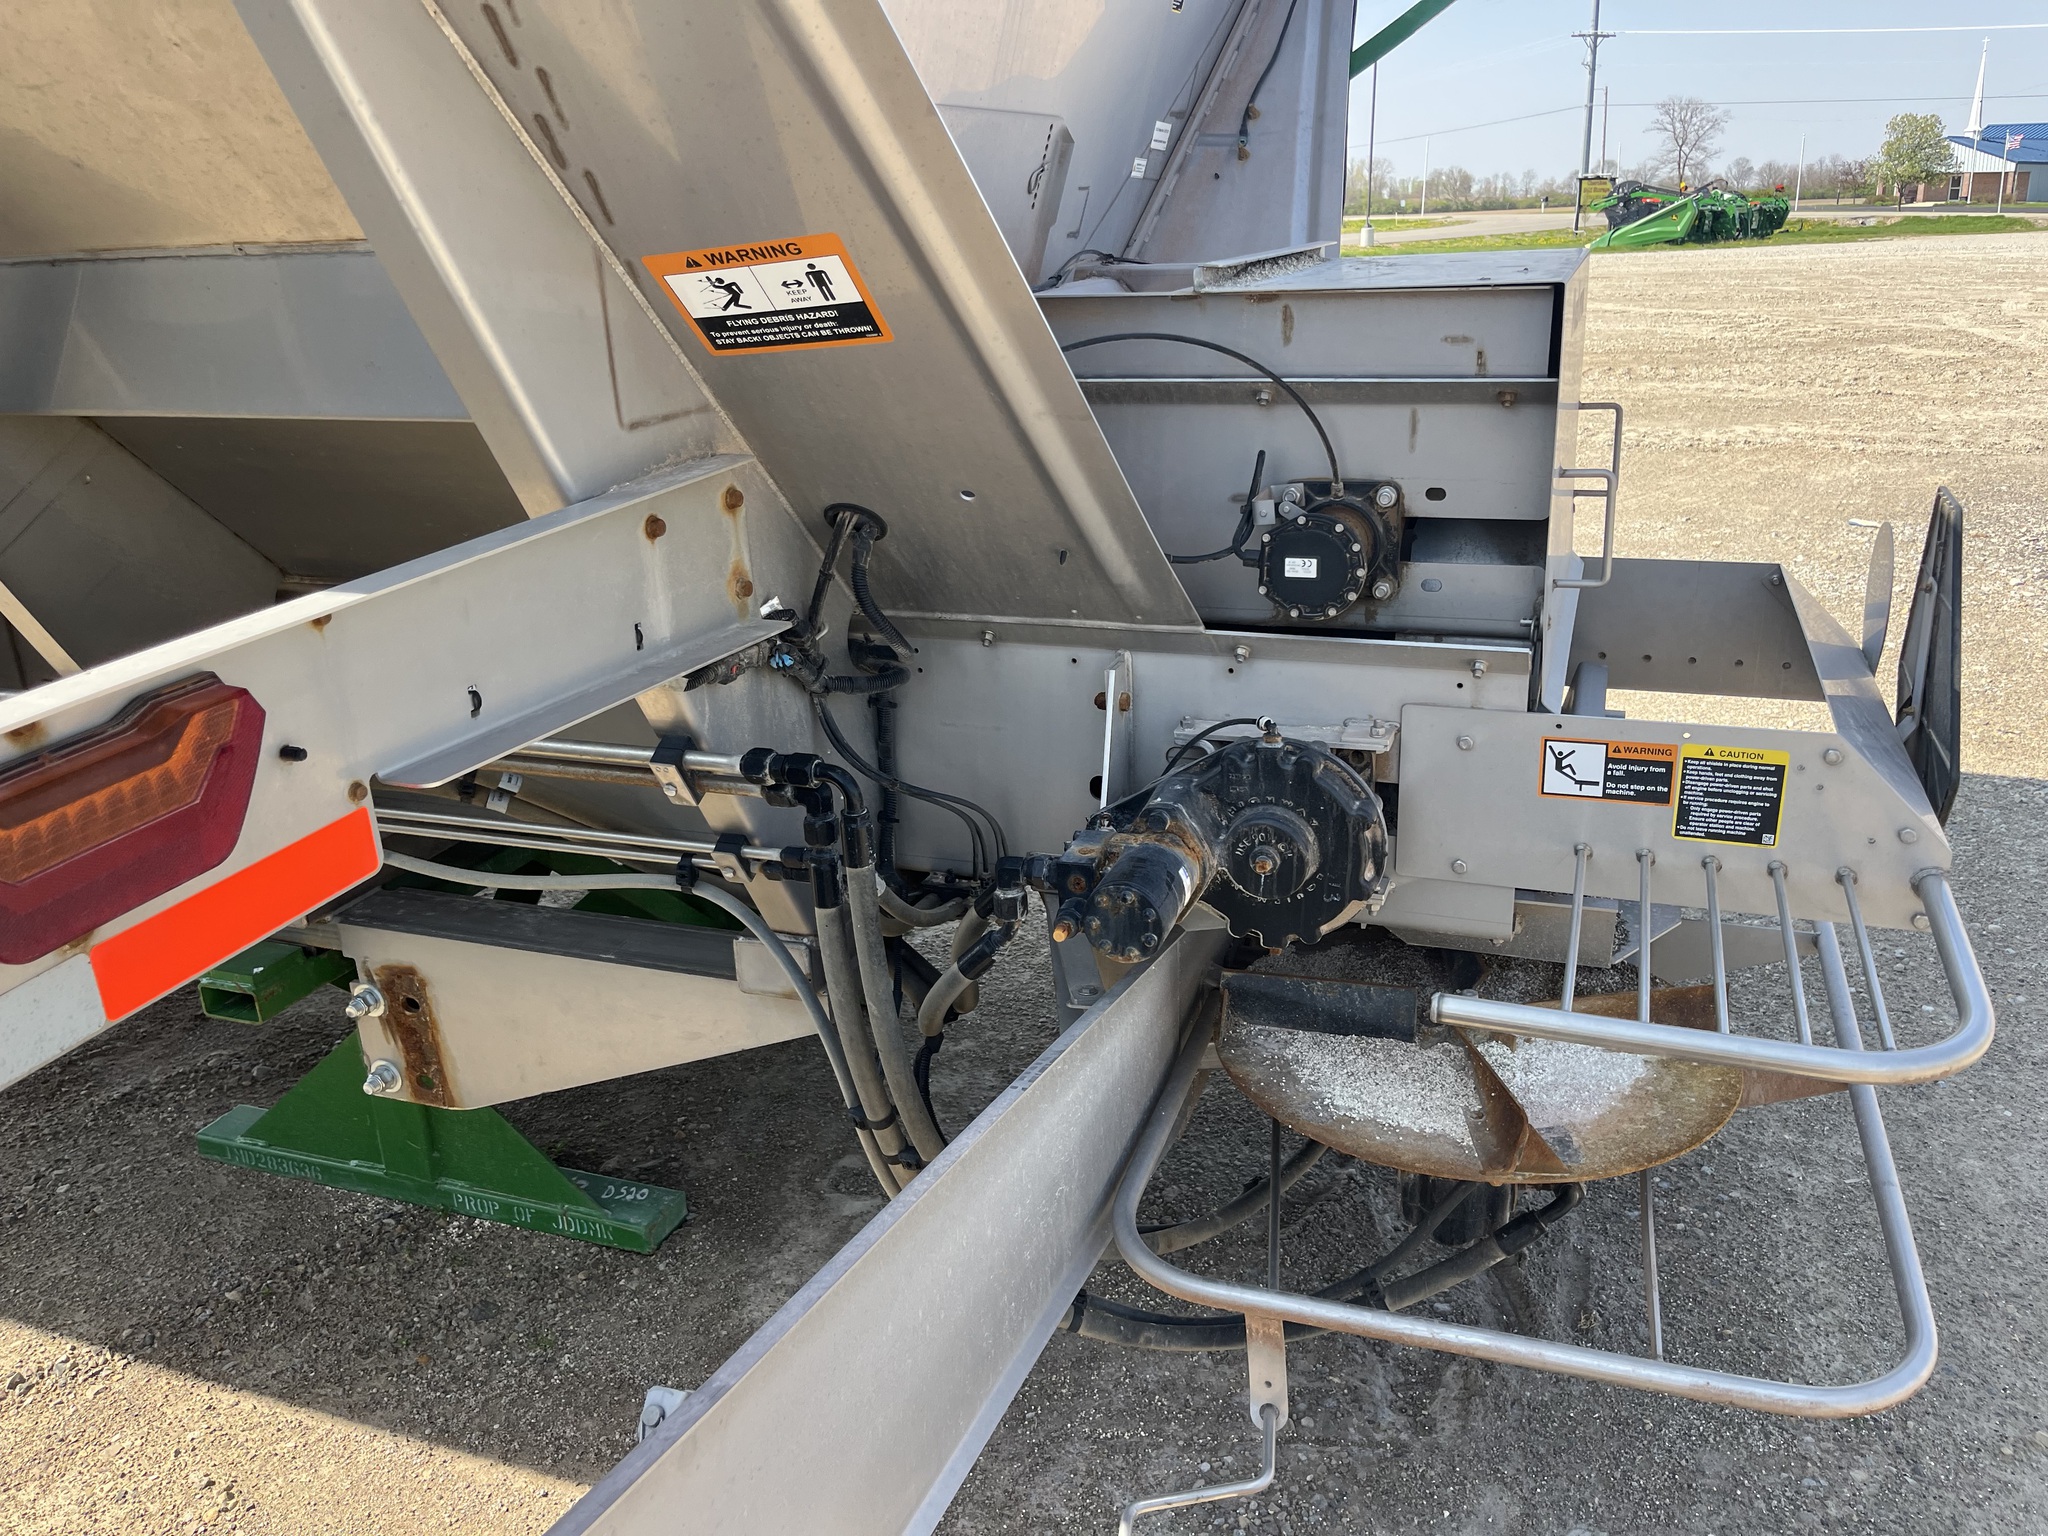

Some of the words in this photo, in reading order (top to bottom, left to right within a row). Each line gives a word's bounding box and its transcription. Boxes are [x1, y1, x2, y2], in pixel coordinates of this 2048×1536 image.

[704, 242, 802, 266] WARNING
[726, 318, 759, 328] FLYING
[760, 314, 794, 324] DEBRIS
[796, 310, 838, 320] HAZARD!
[722, 328, 750, 338] prevent
[780, 325, 802, 334] injury
[814, 321, 838, 329] death:
[737, 336, 762, 344] BACK!
[764, 332, 800, 342] OBJECTS
[833, 325, 874, 334] THROWN!
[1623, 746, 1672, 756] WARNING
[1720, 750, 1764, 760] CAUTION
[453, 1192, 500, 1215] PROP
[514, 1208, 535, 1223] OF
